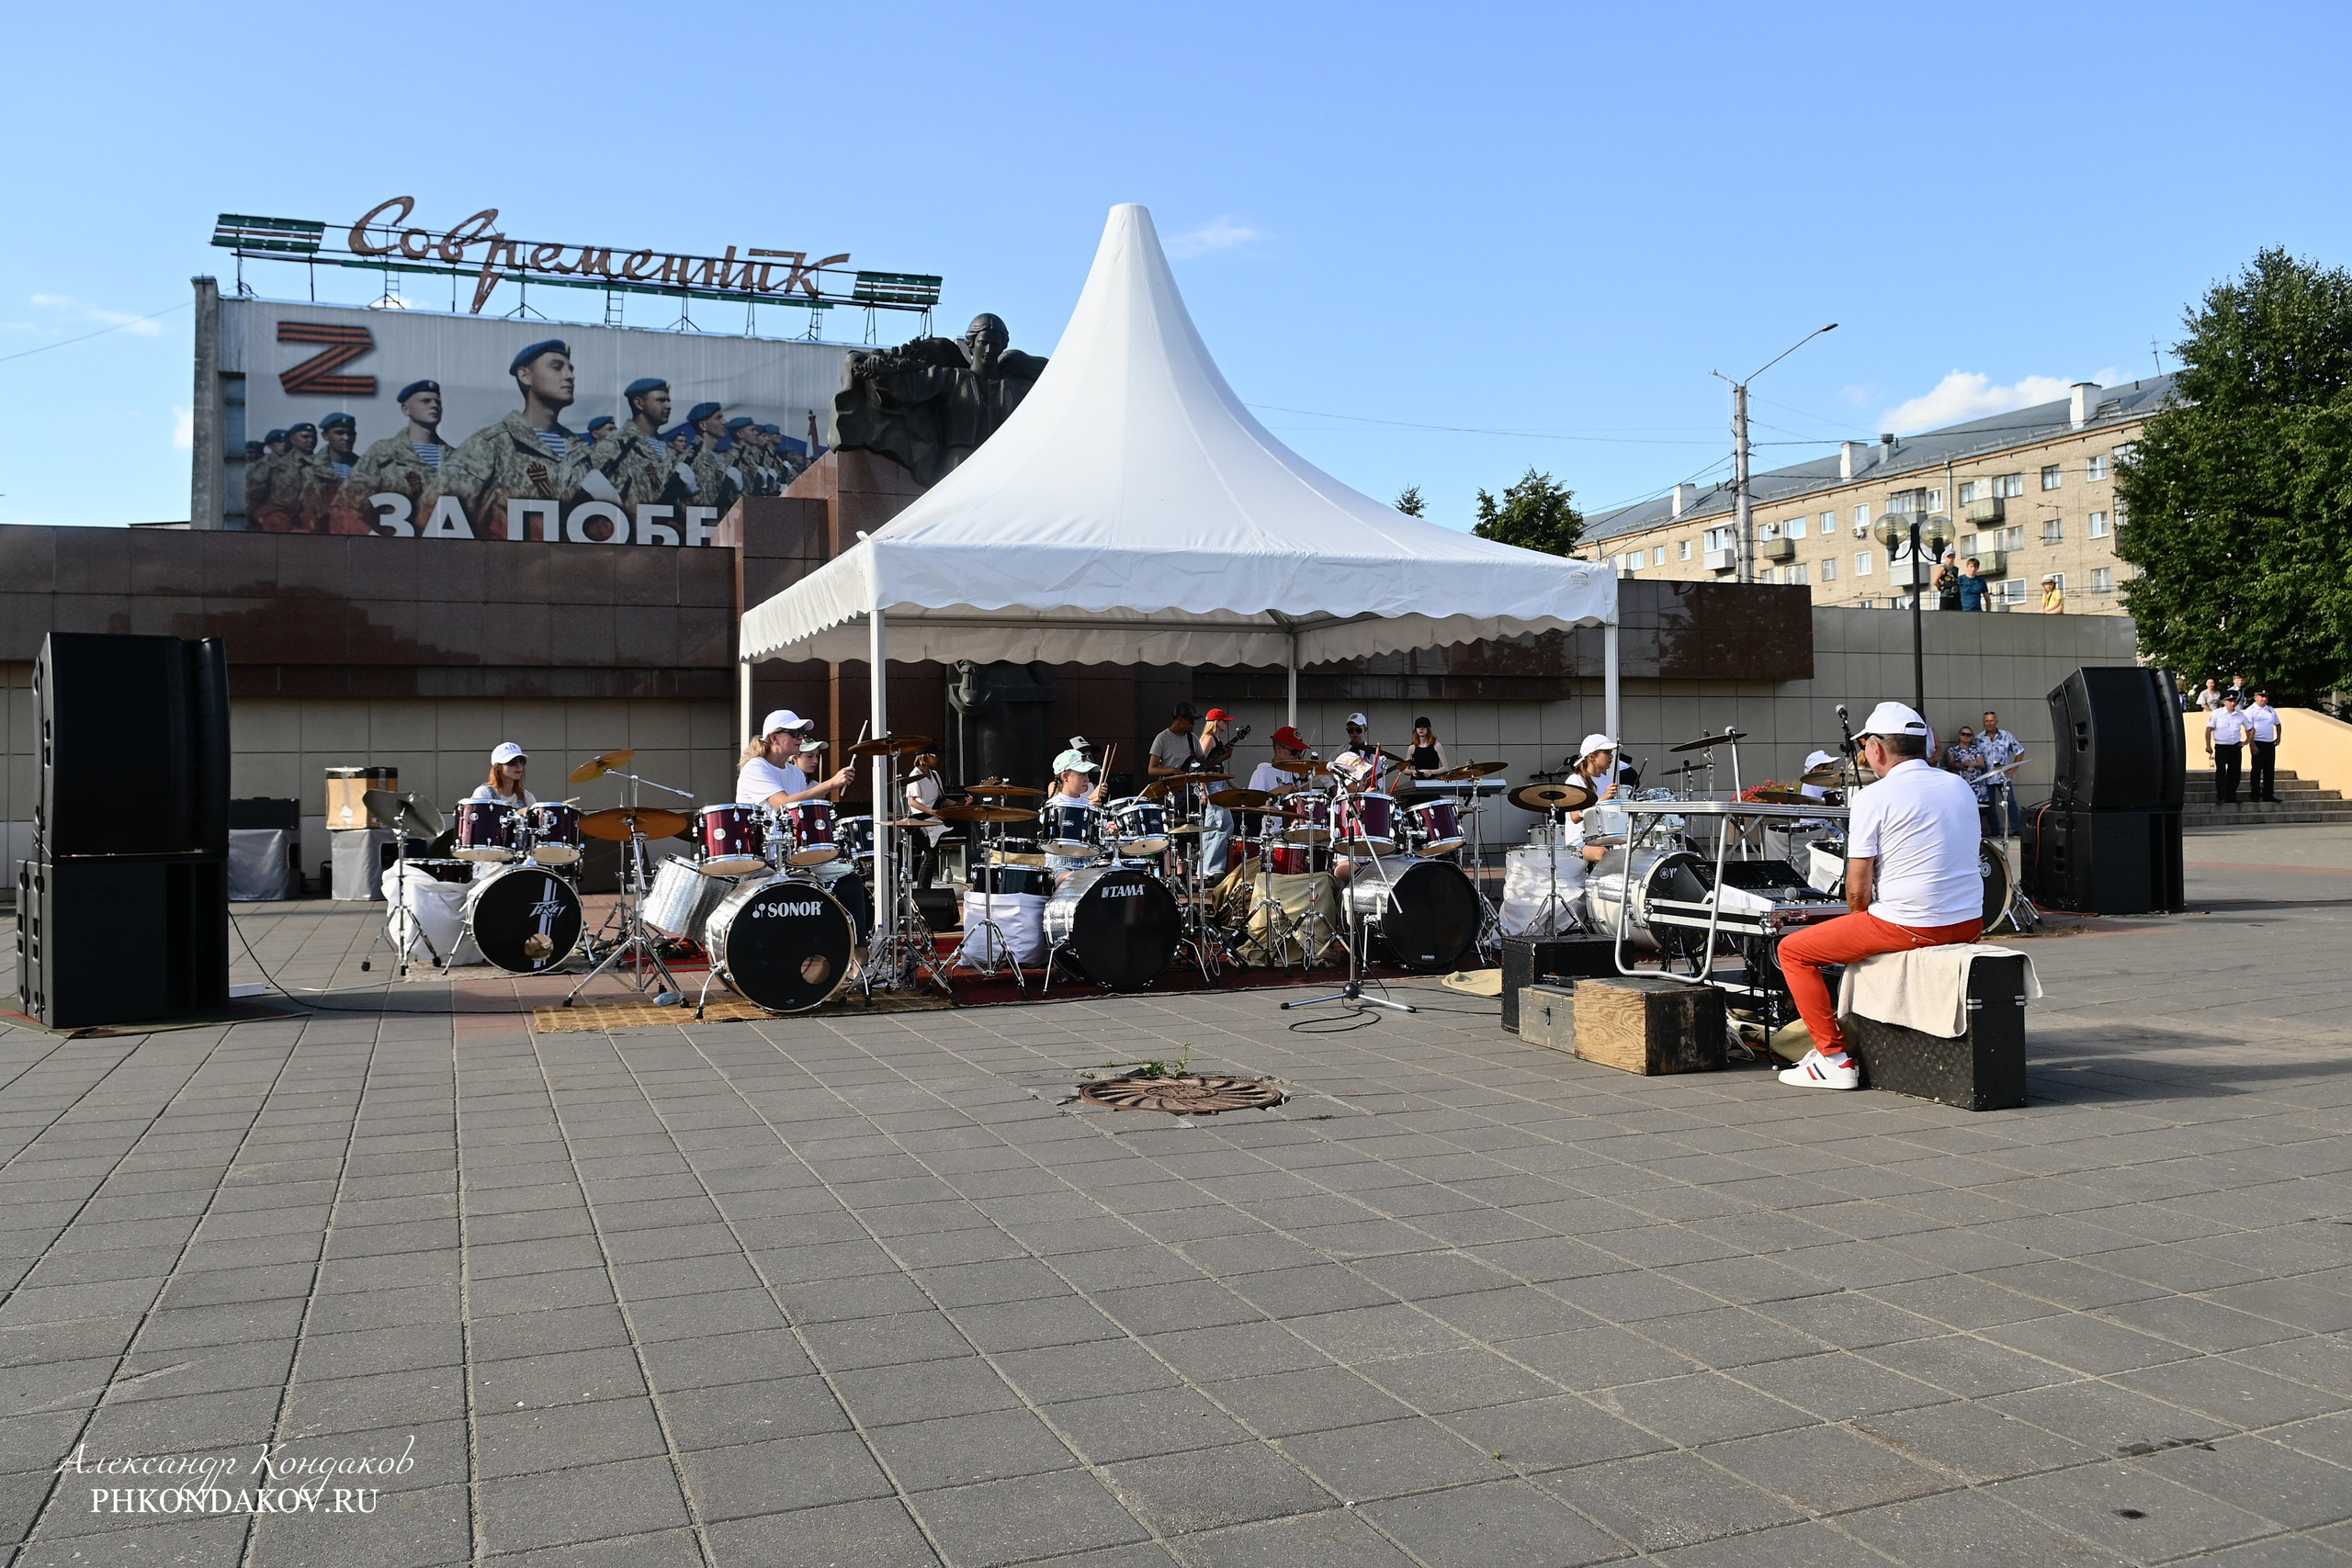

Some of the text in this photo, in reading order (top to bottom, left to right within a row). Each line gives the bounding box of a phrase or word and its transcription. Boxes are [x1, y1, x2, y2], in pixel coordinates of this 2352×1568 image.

[348, 196, 851, 314] Современник
[277, 321, 376, 396] Z
[368, 492, 475, 539] ЗА
[768, 901, 821, 918] SONOR
[1109, 884, 1144, 898] TAMA
